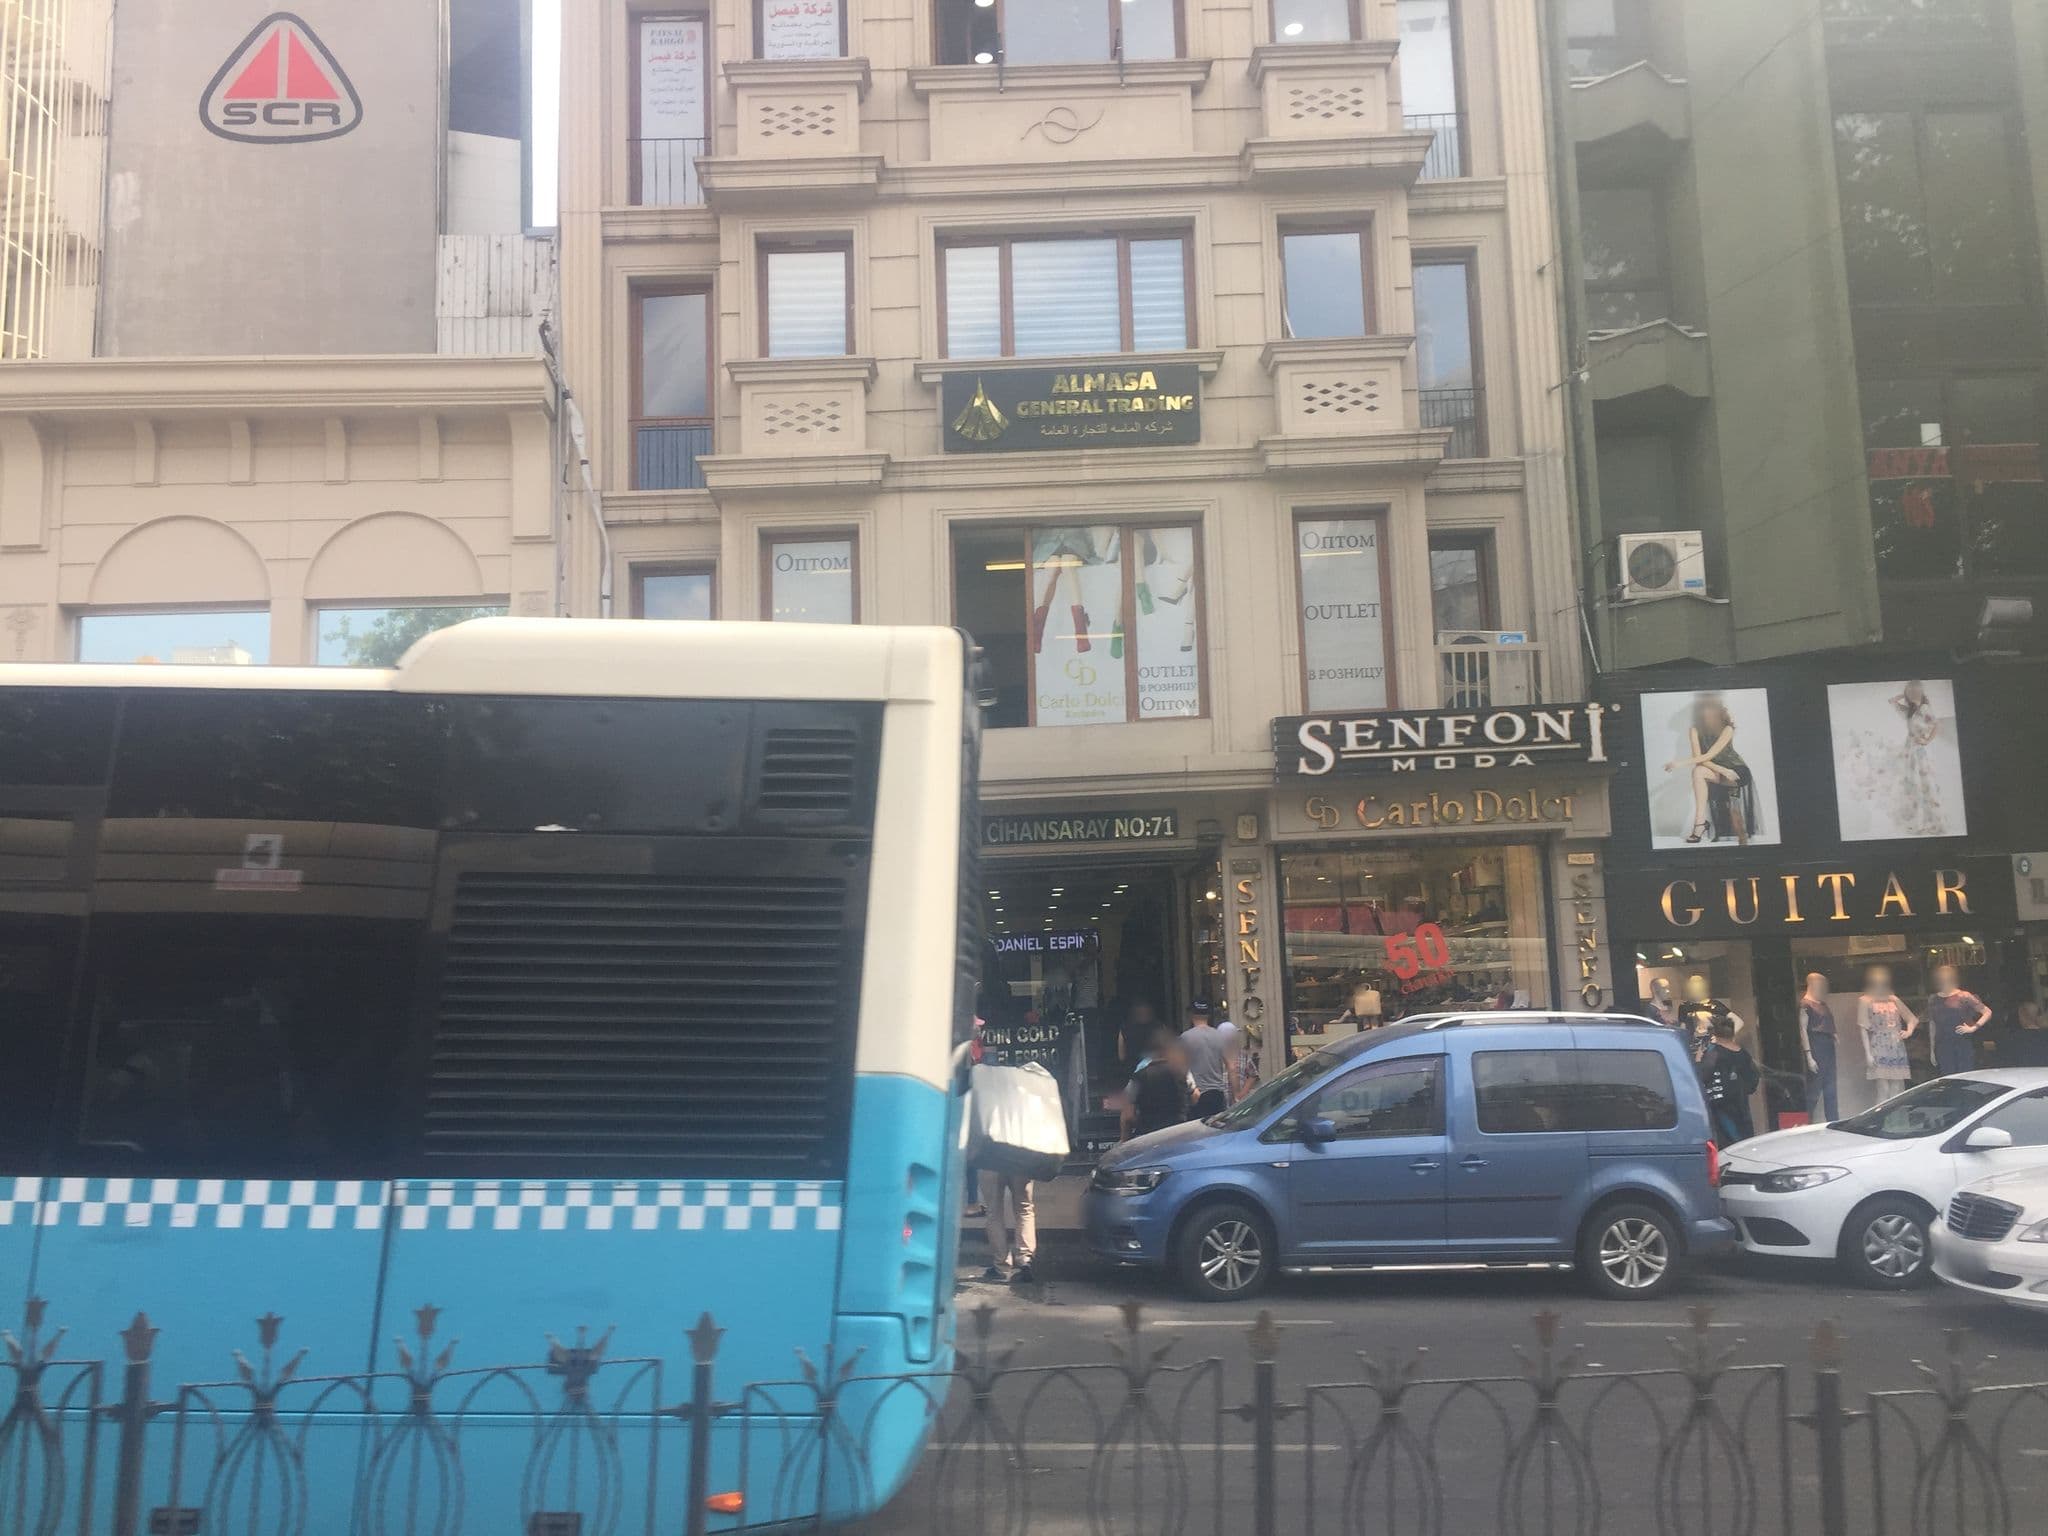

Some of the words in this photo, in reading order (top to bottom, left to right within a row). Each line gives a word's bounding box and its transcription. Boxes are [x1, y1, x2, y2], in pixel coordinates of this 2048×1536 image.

[223, 102, 341, 126] SCR
[1052, 371, 1157, 393] ALMASA
[1016, 399, 1103, 417] GENERAL
[1305, 603, 1380, 621] OUTLET
[1139, 666, 1196, 679] OUTLET
[1392, 753, 1535, 772] MODA
[1357, 792, 1465, 829] Carlo
[1114, 816, 1174, 838] NO:71
[1661, 868, 1974, 927] GUITAR
